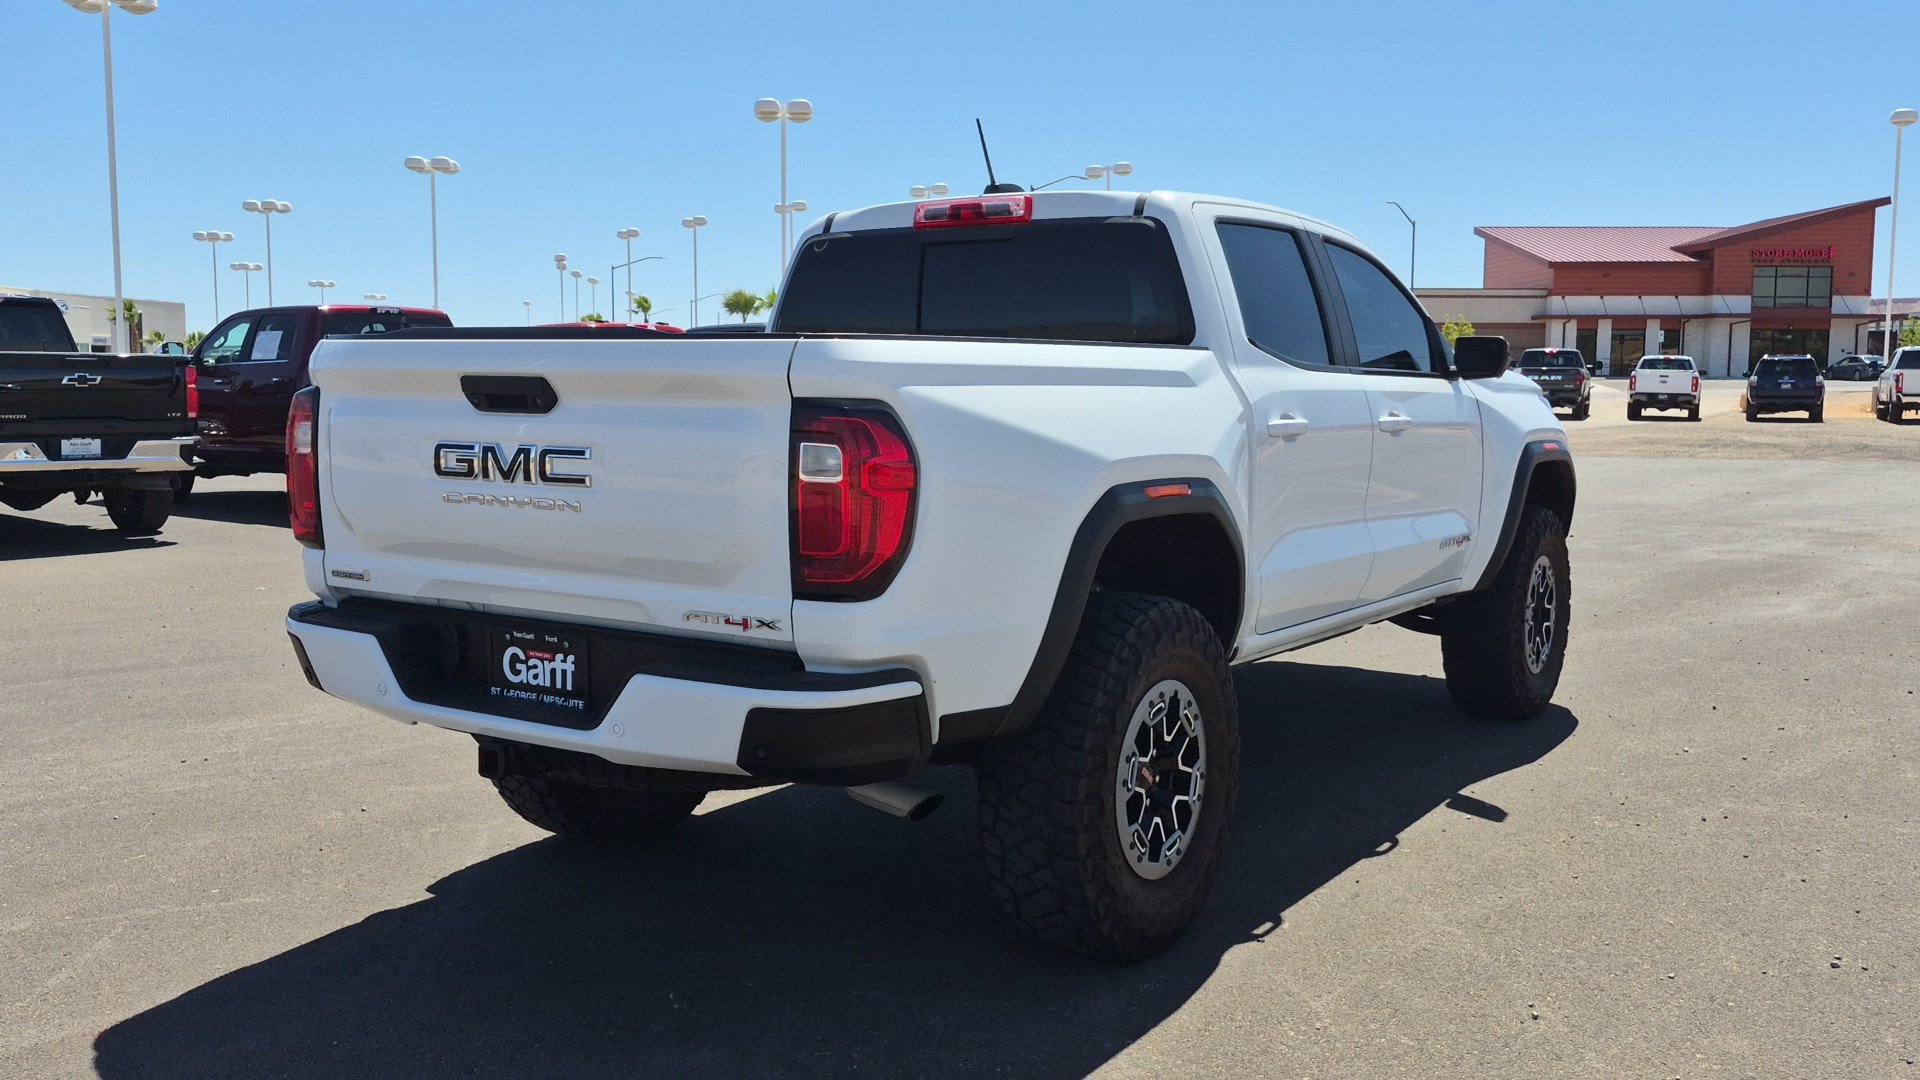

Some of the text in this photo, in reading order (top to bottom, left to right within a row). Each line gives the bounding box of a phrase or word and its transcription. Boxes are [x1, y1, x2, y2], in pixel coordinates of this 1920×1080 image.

[1752, 248, 1790, 258] STORE
[433, 439, 592, 488] GMC
[441, 492, 582, 513] CANYON
[682, 610, 783, 631] AT4X
[503, 646, 575, 691] Garff
[490, 686, 501, 695] ST
[504, 688, 537, 700] GEORGE
